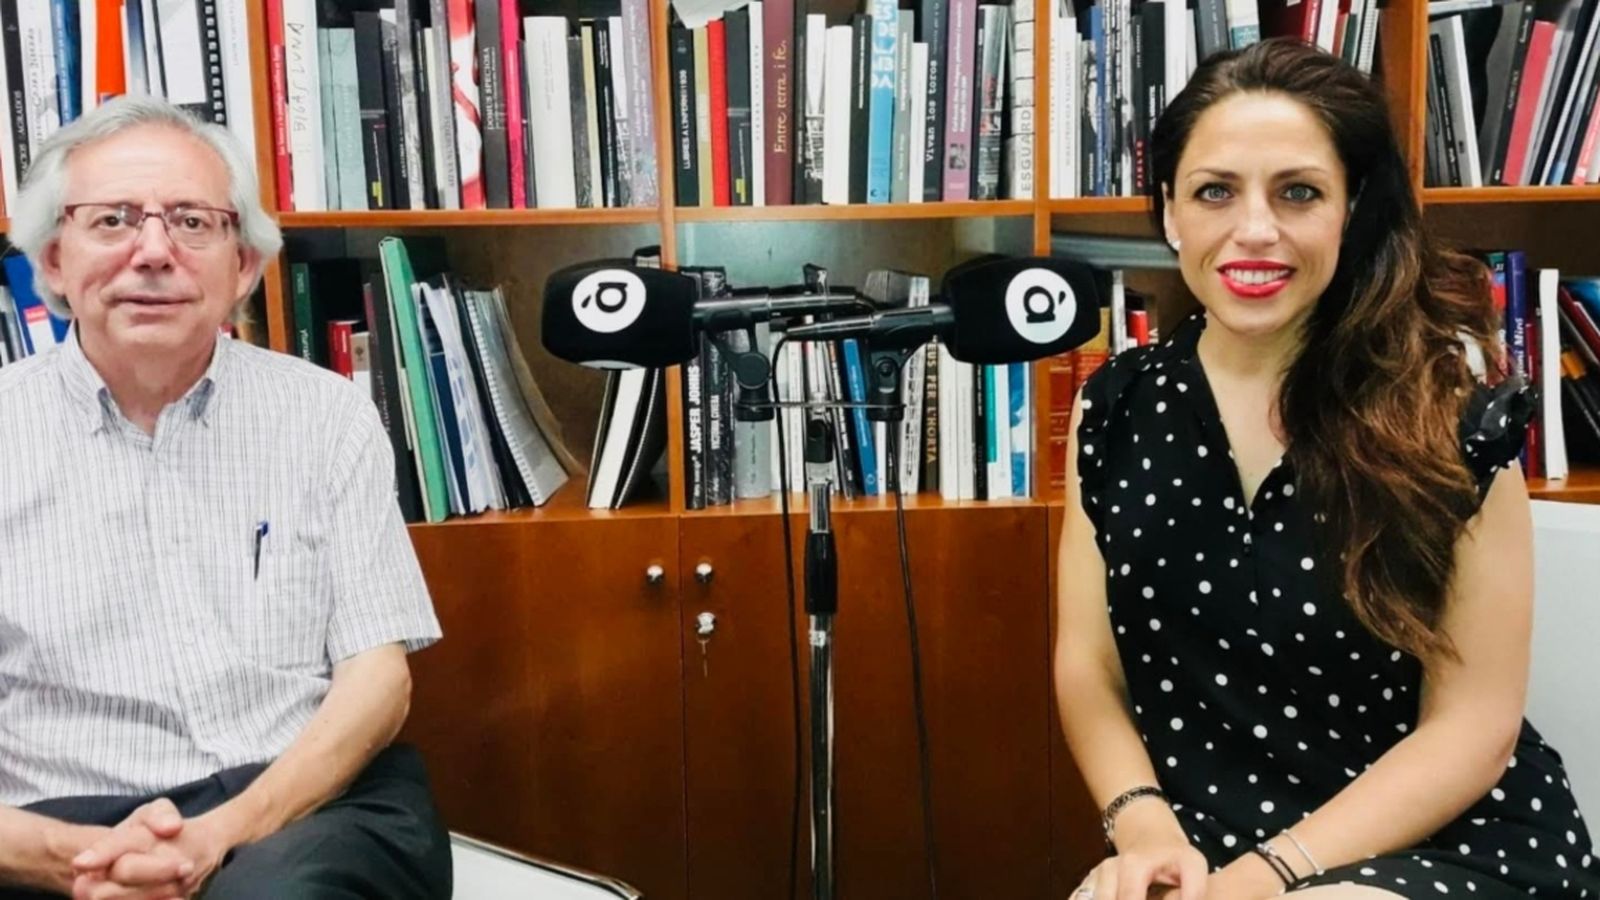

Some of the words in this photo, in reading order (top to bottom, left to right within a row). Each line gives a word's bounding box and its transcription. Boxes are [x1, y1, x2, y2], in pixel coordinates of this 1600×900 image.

[483, 47, 493, 94] SPECIOSA
[928, 60, 938, 95] toros
[776, 73, 787, 109] terra
[485, 95, 495, 129] DOMUS
[927, 101, 937, 121] los
[774, 112, 787, 153] Entre
[925, 127, 936, 162] Vivan
[1020, 100, 1032, 191] ESGUARDS
[687, 364, 701, 406] JOHNS
[926, 375, 938, 398] PER
[688, 408, 702, 454] JASPER
[926, 407, 938, 464] L'HORTA
